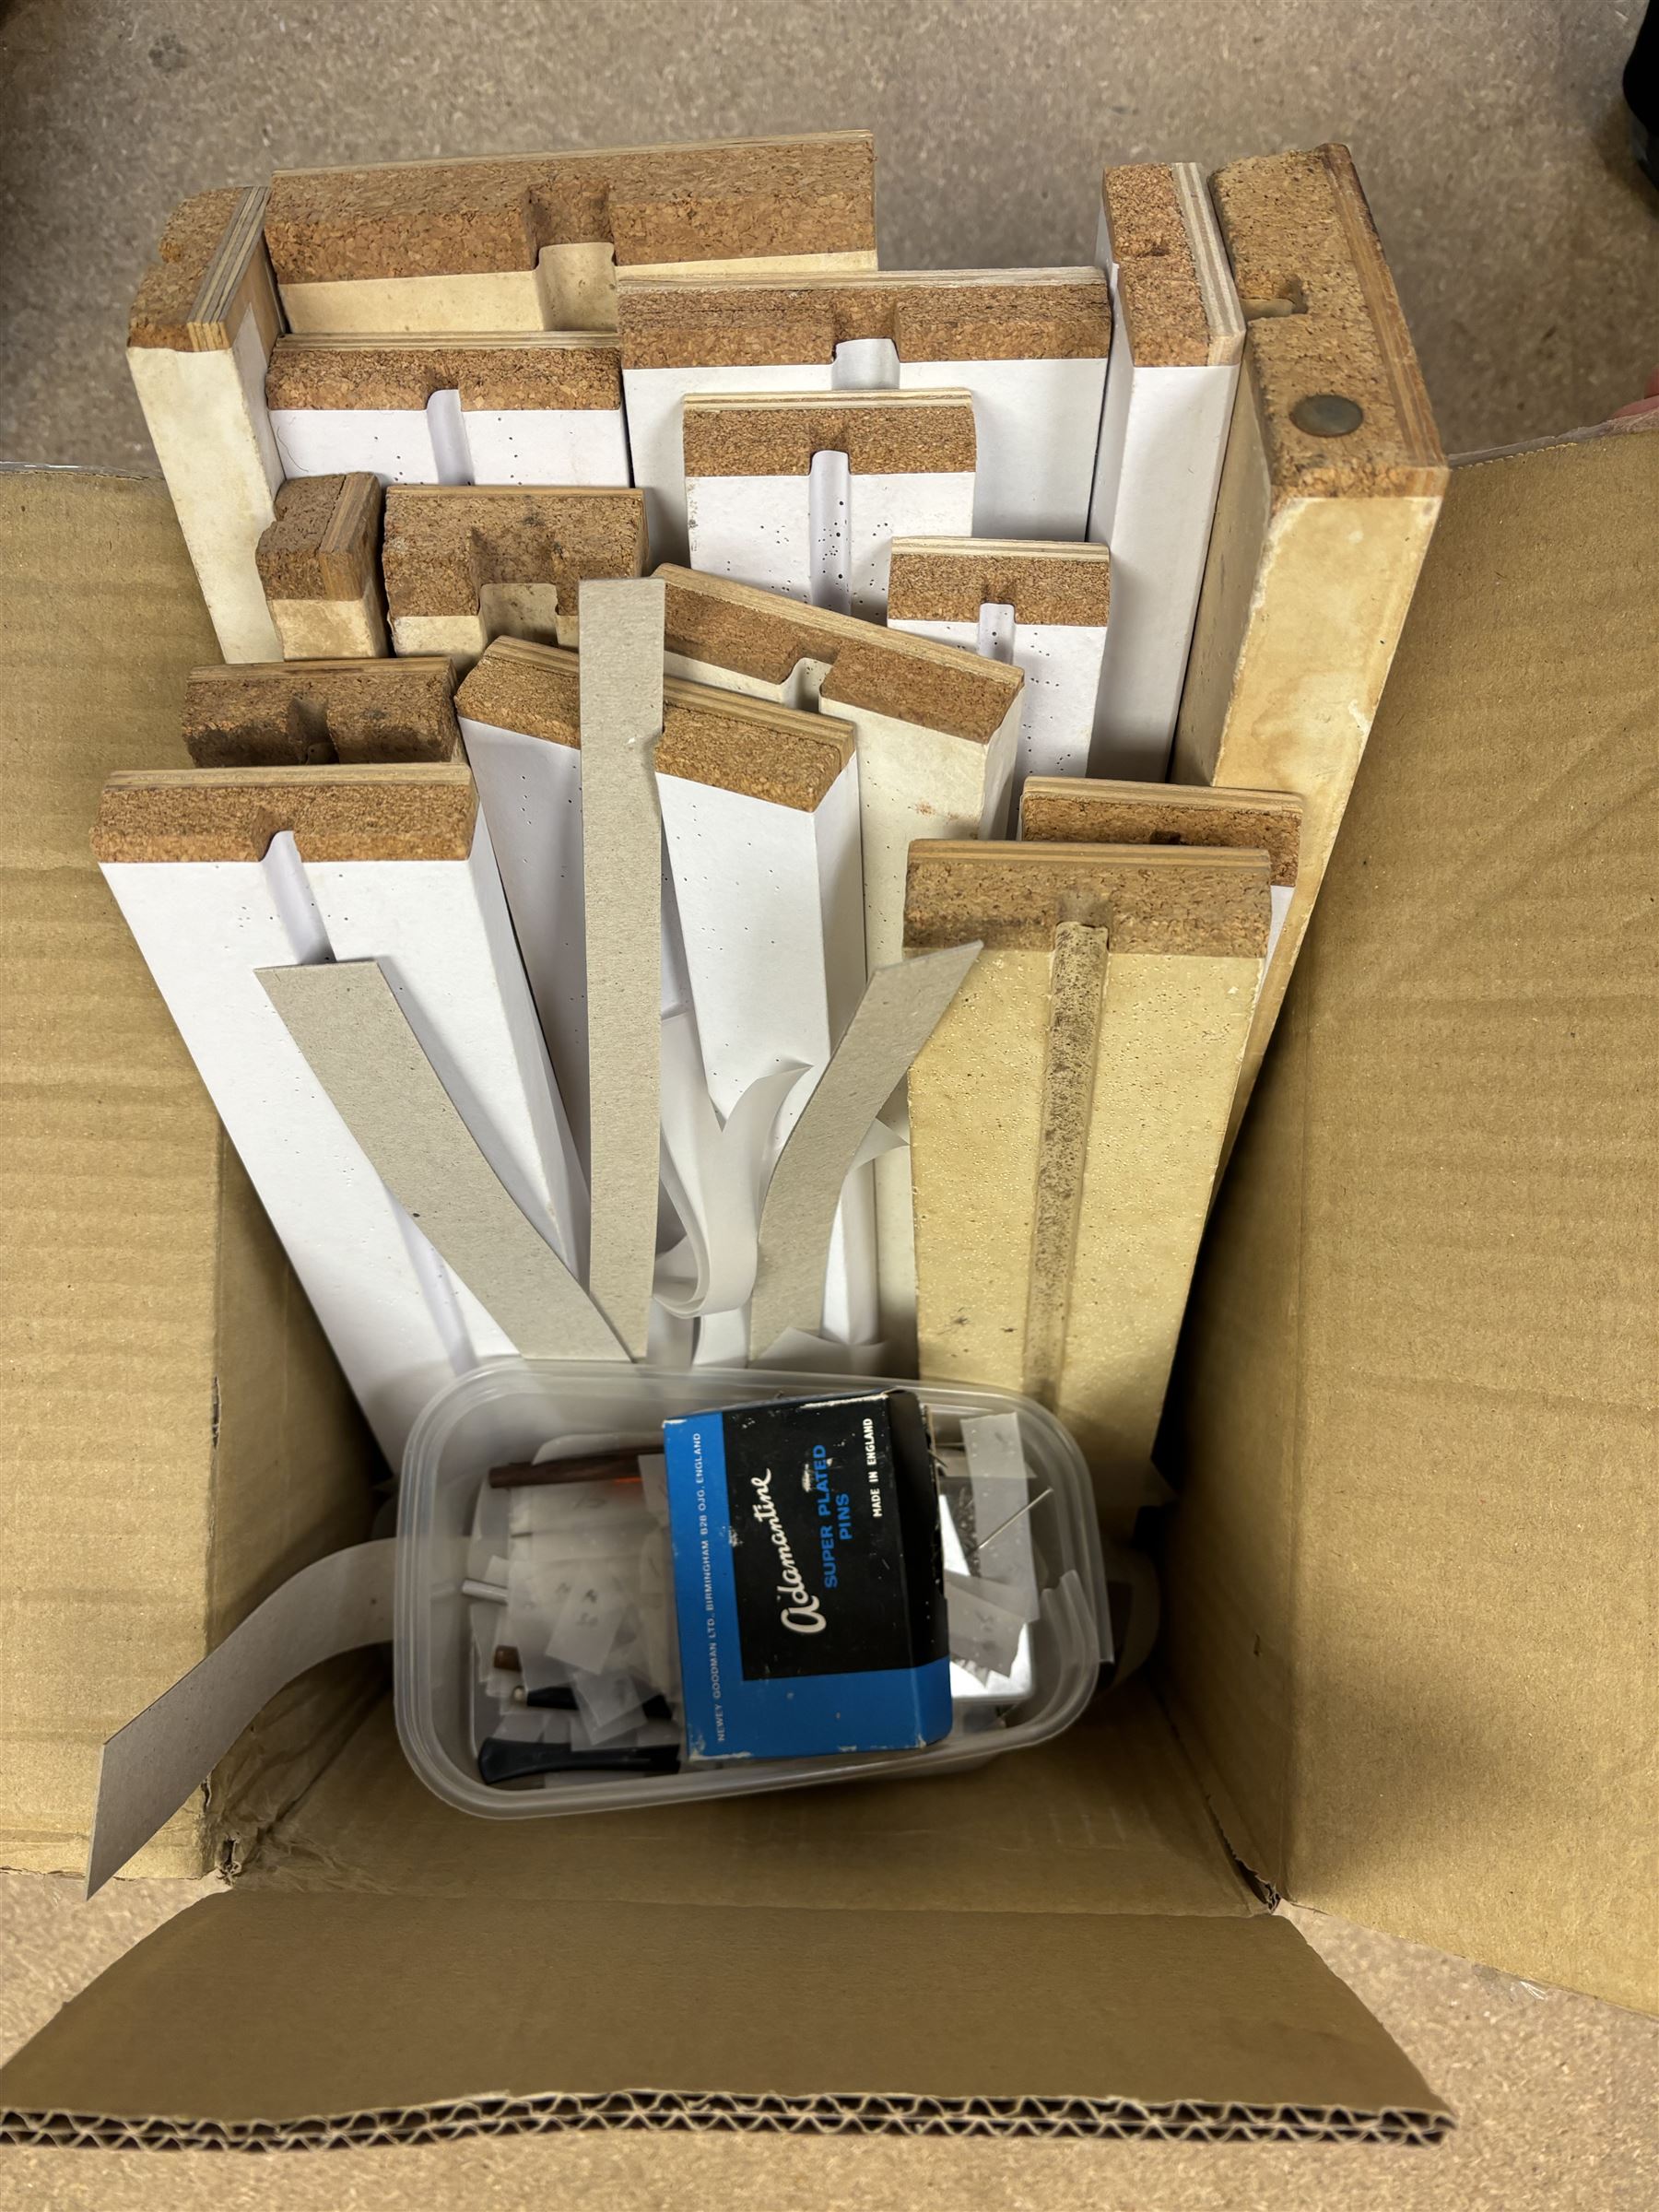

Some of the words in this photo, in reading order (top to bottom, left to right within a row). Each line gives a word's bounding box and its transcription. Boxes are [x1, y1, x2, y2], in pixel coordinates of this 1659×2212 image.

[693, 1432, 704, 1484] ENGLAND
[864, 1418, 877, 1465] ENGLAND
[813, 1444, 832, 1516] PLATED
[868, 1471, 878, 1483] IN
[699, 1514, 708, 1535] B28
[836, 1493, 852, 1540] PINS
[869, 1488, 882, 1518] MADE
[751, 1468, 827, 1633] Adamantine
[820, 1525, 838, 1589] SUPER
[701, 1540, 714, 1611] BIRMINGHAM
[710, 1642, 721, 1699] GOODMAN
[715, 1703, 725, 1741] NEWEY
